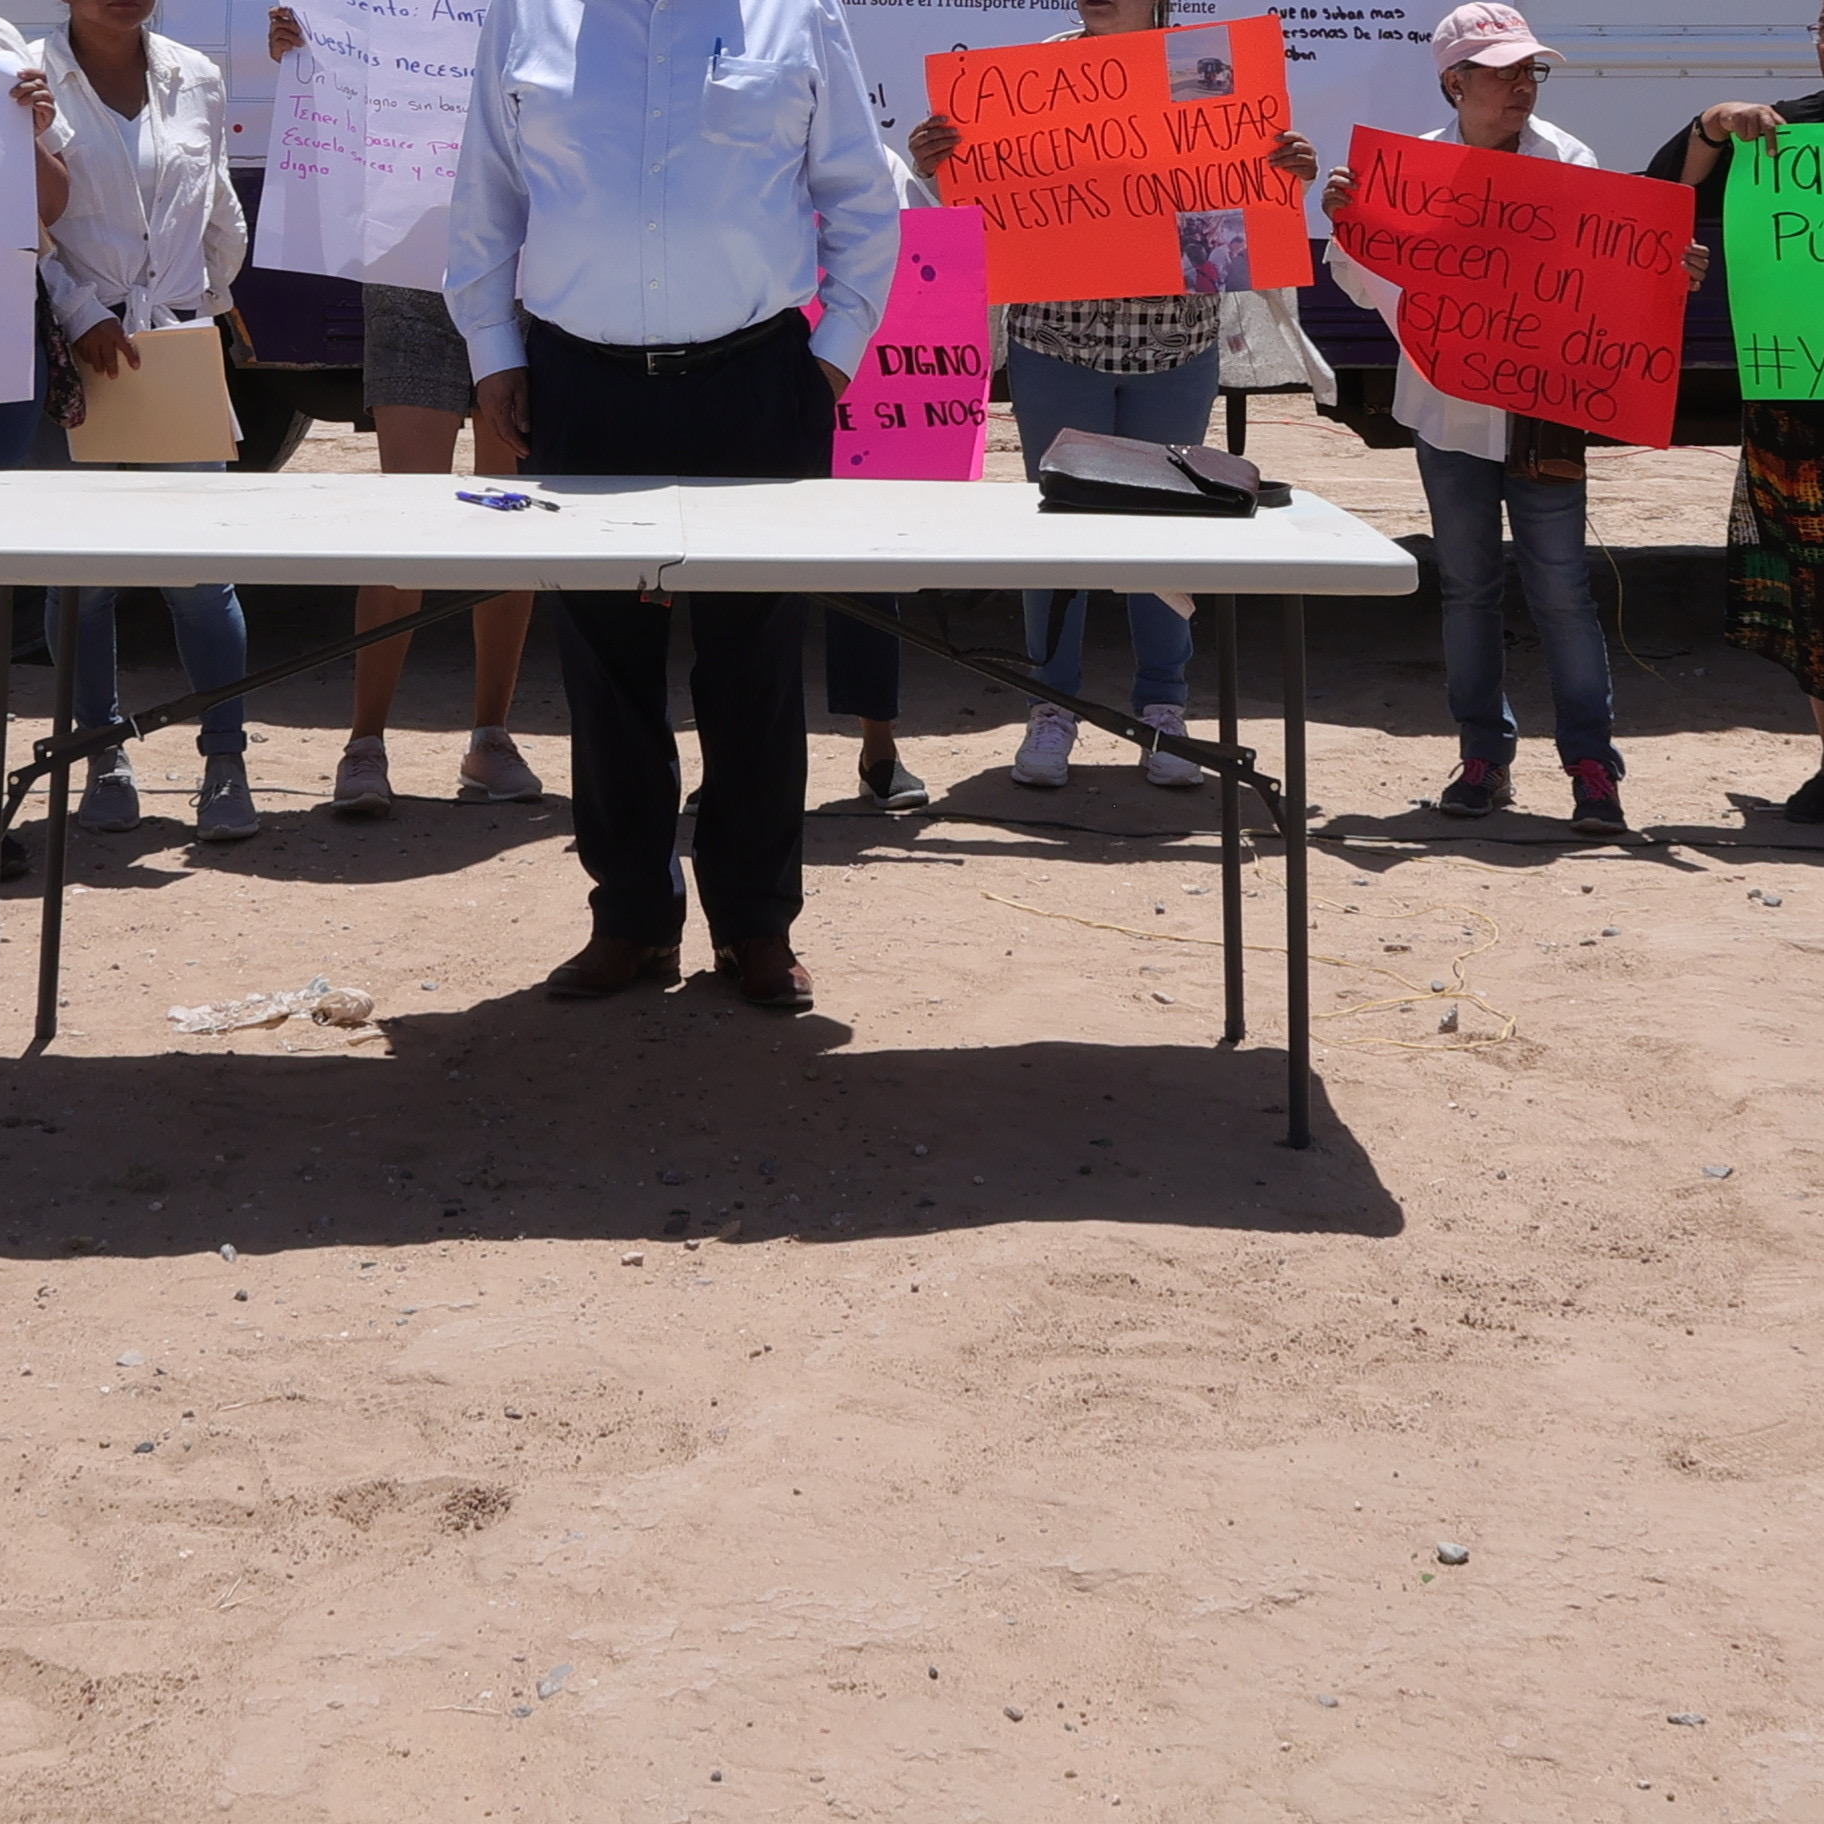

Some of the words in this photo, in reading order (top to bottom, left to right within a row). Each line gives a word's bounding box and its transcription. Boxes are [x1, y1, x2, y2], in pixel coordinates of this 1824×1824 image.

[1300, 7, 1318, 19] no
[1370, 7, 1406, 20] mas
[1377, 26, 1404, 41] las
[1407, 29, 1432, 45] que
[948, 57, 1129, 125] ¿ACASO
[949, 113, 1148, 185] MERECEMOS
[1162, 94, 1288, 156] VIAJAR
[1015, 177, 1110, 231] ESTAS
[1365, 148, 1557, 242] Nuestros
[1576, 210, 1673, 276] niños
[1336, 218, 1511, 289] merecen
[1534, 261, 1585, 313] un
[876, 344, 989, 381] DIGNO,
[1560, 314, 1676, 387] digno
[874, 401, 907, 430] SI
[923, 397, 986, 428] NOS
